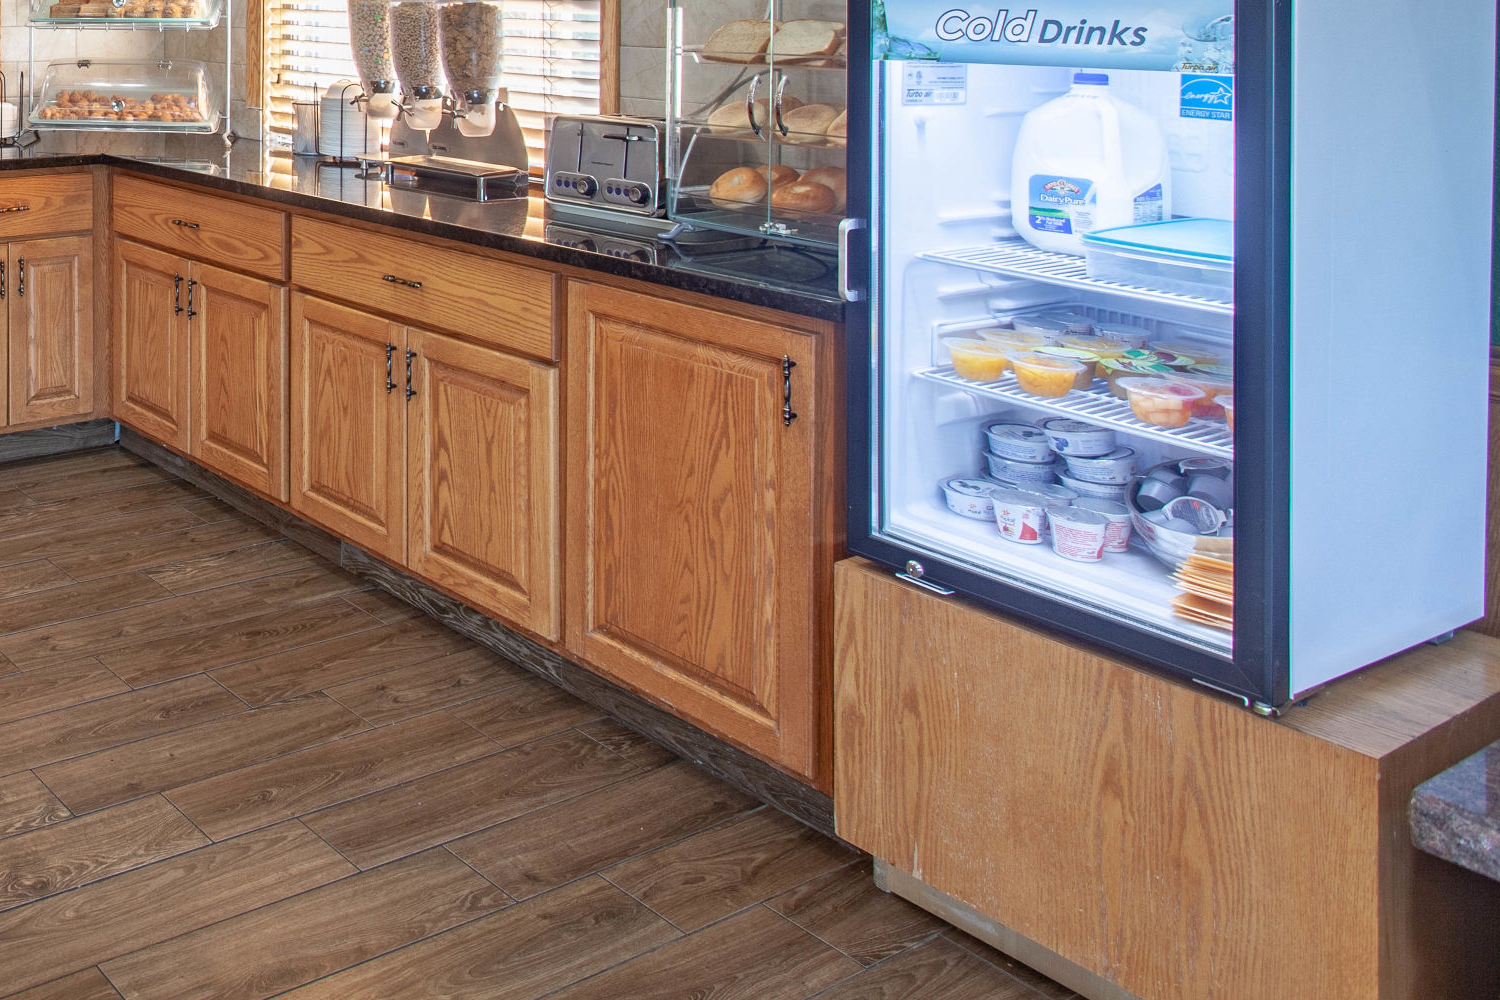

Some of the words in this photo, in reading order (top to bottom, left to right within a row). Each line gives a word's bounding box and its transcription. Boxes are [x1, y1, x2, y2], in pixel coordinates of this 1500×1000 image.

[935, 8, 1038, 43] Cold
[1038, 18, 1148, 47] Drinks
[1181, 109, 1209, 117] ENERGY
[1211, 111, 1231, 119] STAR
